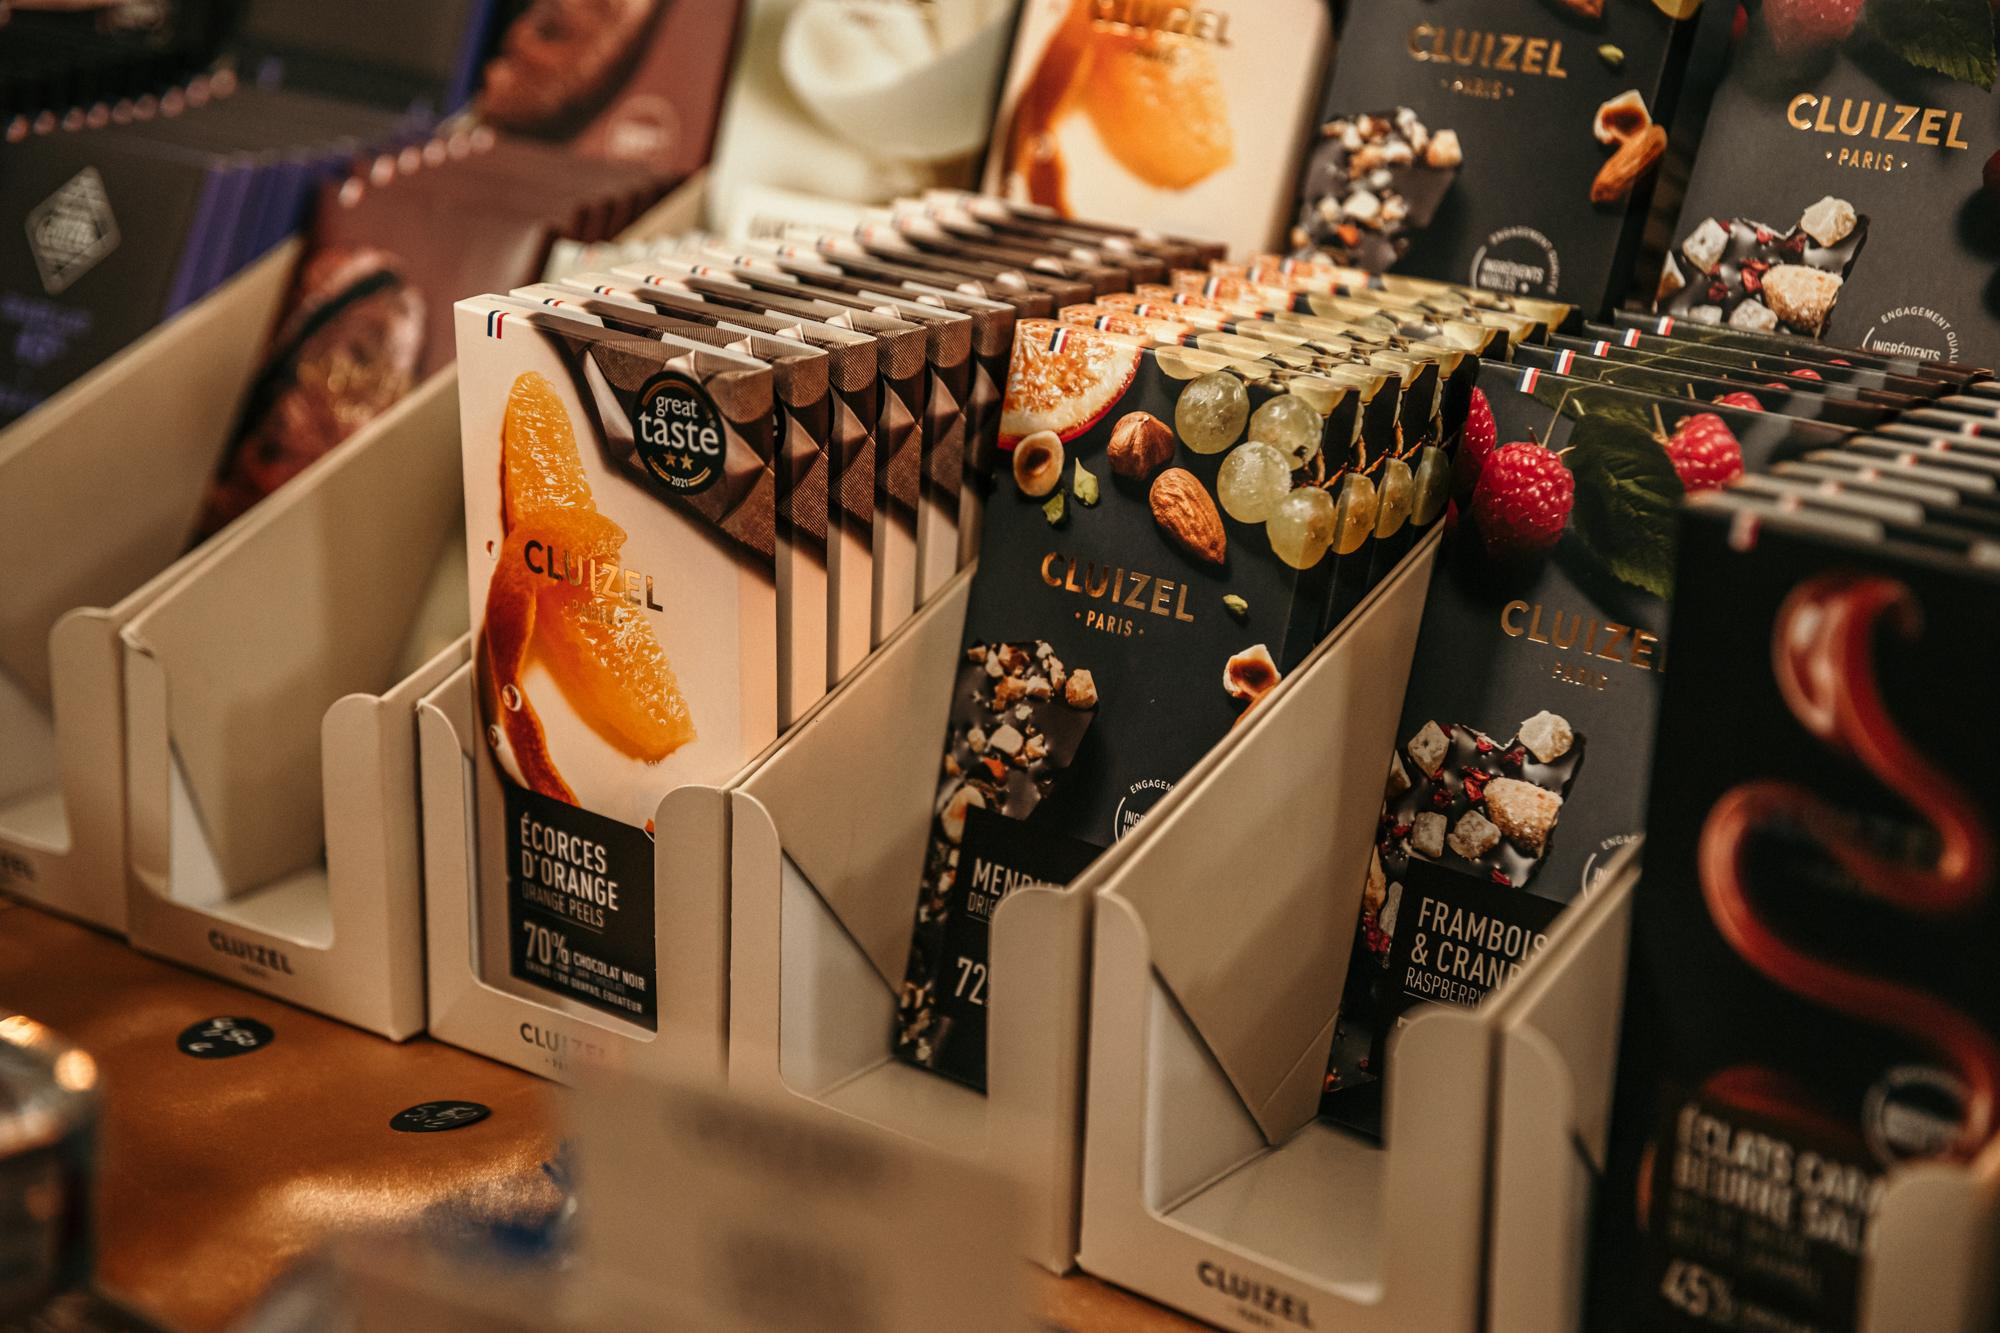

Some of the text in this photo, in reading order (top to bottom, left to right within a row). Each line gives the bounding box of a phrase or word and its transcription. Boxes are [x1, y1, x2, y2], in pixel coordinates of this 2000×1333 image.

[1408, 22, 1567, 78] CLUIZEL
[1787, 92, 1968, 150] CLUIZEL
[1838, 148, 1894, 172] PARIS
[1881, 306, 1951, 330] ENGAGEMENT
[656, 396, 698, 418] great
[638, 411, 720, 456] taste
[671, 475, 689, 488] 2021
[524, 540, 663, 613] CLUIZEL
[1041, 552, 1194, 623] CLUIZEL
[1086, 610, 1133, 637] PARIS
[521, 811, 608, 875] ÉCORCES
[522, 850, 619, 911] D'ORANGE
[522, 881, 604, 928] ORANGE PEELS
[523, 921, 569, 965] 70%
[573, 952, 620, 981] CHOCOLAT
[622, 971, 646, 992] NOIR
[1411, 933, 1429, 966] &
[955, 956, 992, 1006] 72
[1197, 1261, 1314, 1331] CLUIZEL
